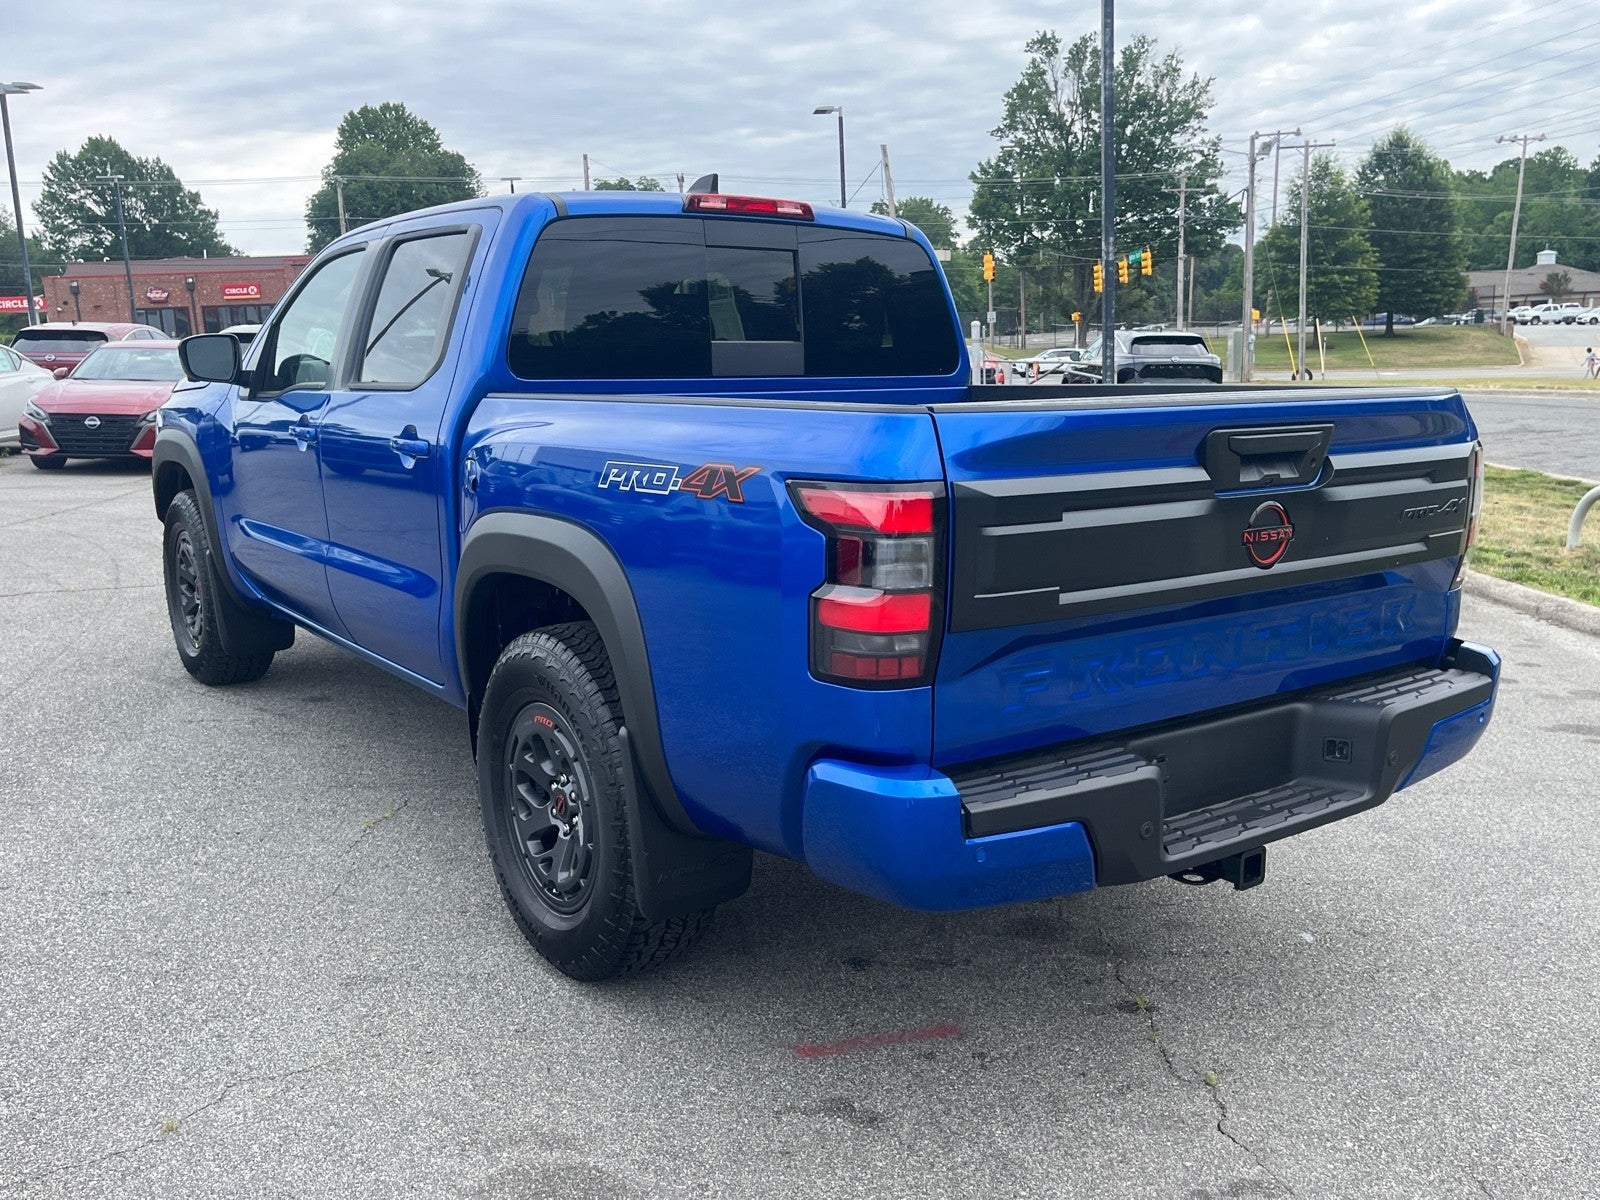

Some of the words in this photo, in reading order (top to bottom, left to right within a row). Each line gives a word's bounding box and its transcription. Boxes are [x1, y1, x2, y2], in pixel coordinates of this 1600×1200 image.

[225, 287, 248, 295] CIRCLE
[1243, 527, 1293, 543] NISSAN
[1000, 589, 1419, 715] FRONTIER
[534, 714, 554, 728] PRO
